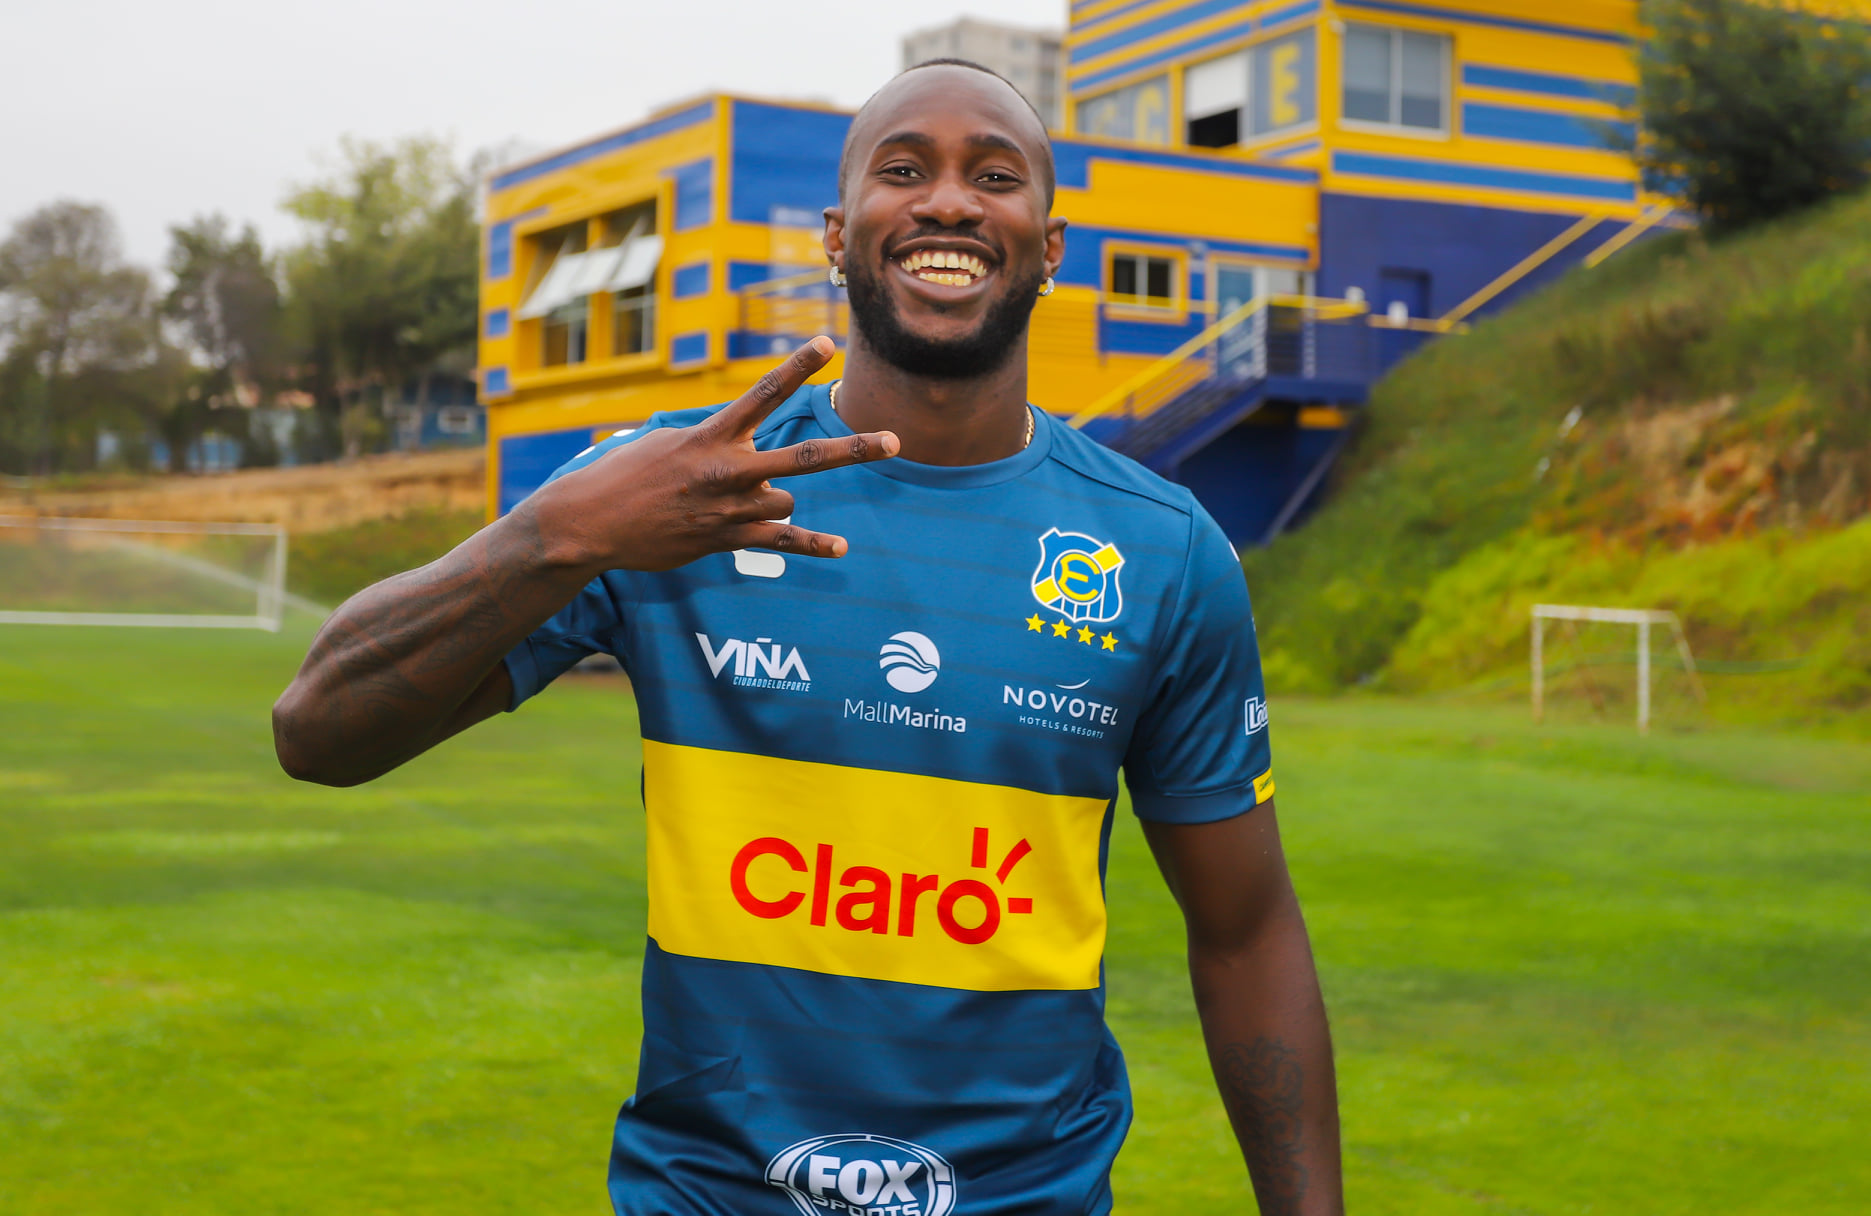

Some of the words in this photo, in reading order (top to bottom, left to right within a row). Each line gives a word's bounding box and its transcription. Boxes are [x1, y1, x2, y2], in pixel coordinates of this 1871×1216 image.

[695, 632, 812, 681] VIÑA
[844, 698, 967, 733] MallMarina
[1003, 684, 1119, 726] NOVOTEL
[1019, 715, 1060, 730] HOTELS
[1062, 723, 1069, 732] &
[1070, 725, 1104, 739] RESORTS
[730, 836, 1000, 945] Claro
[808, 1154, 922, 1206] FOX
